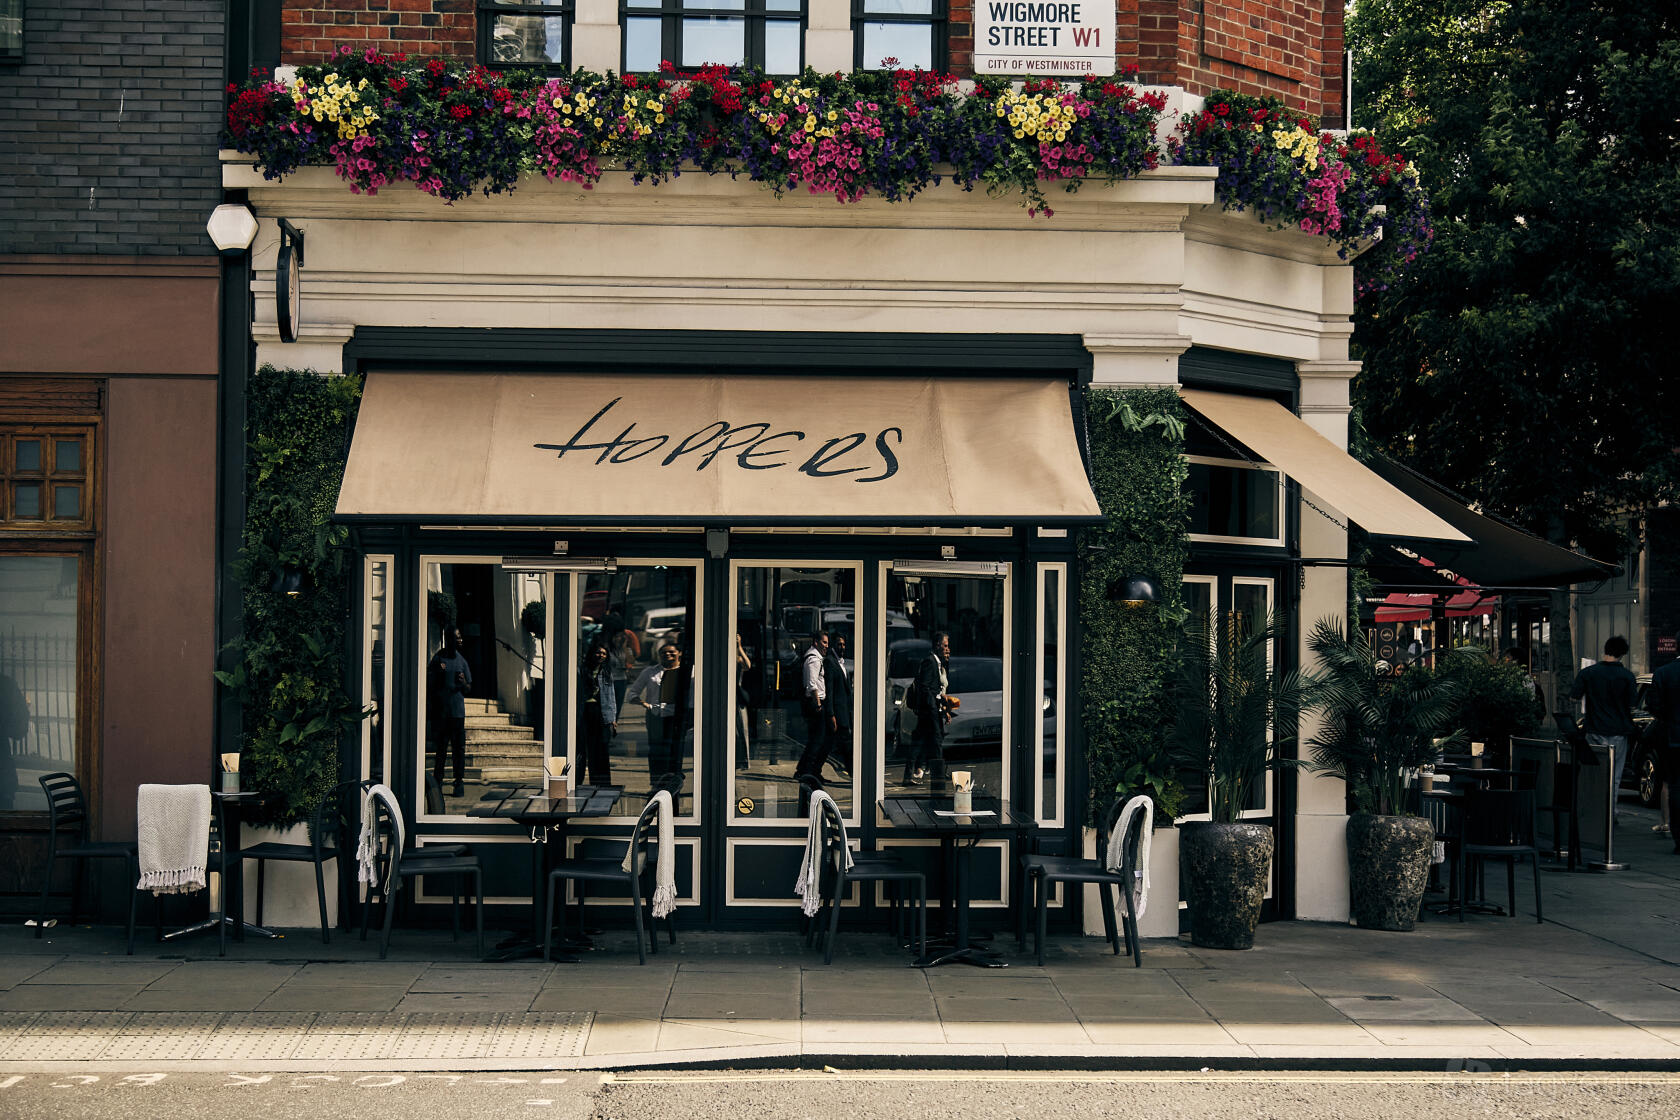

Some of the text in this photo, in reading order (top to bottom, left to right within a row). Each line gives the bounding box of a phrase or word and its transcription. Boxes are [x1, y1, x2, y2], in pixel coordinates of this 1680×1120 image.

[988, 2, 1081, 23] WIGMORE
[988, 26, 1100, 48] STREET W1
[988, 59, 1093, 71] CITY OF WESTMINSTER
[533, 396, 903, 482] HOPPERS
